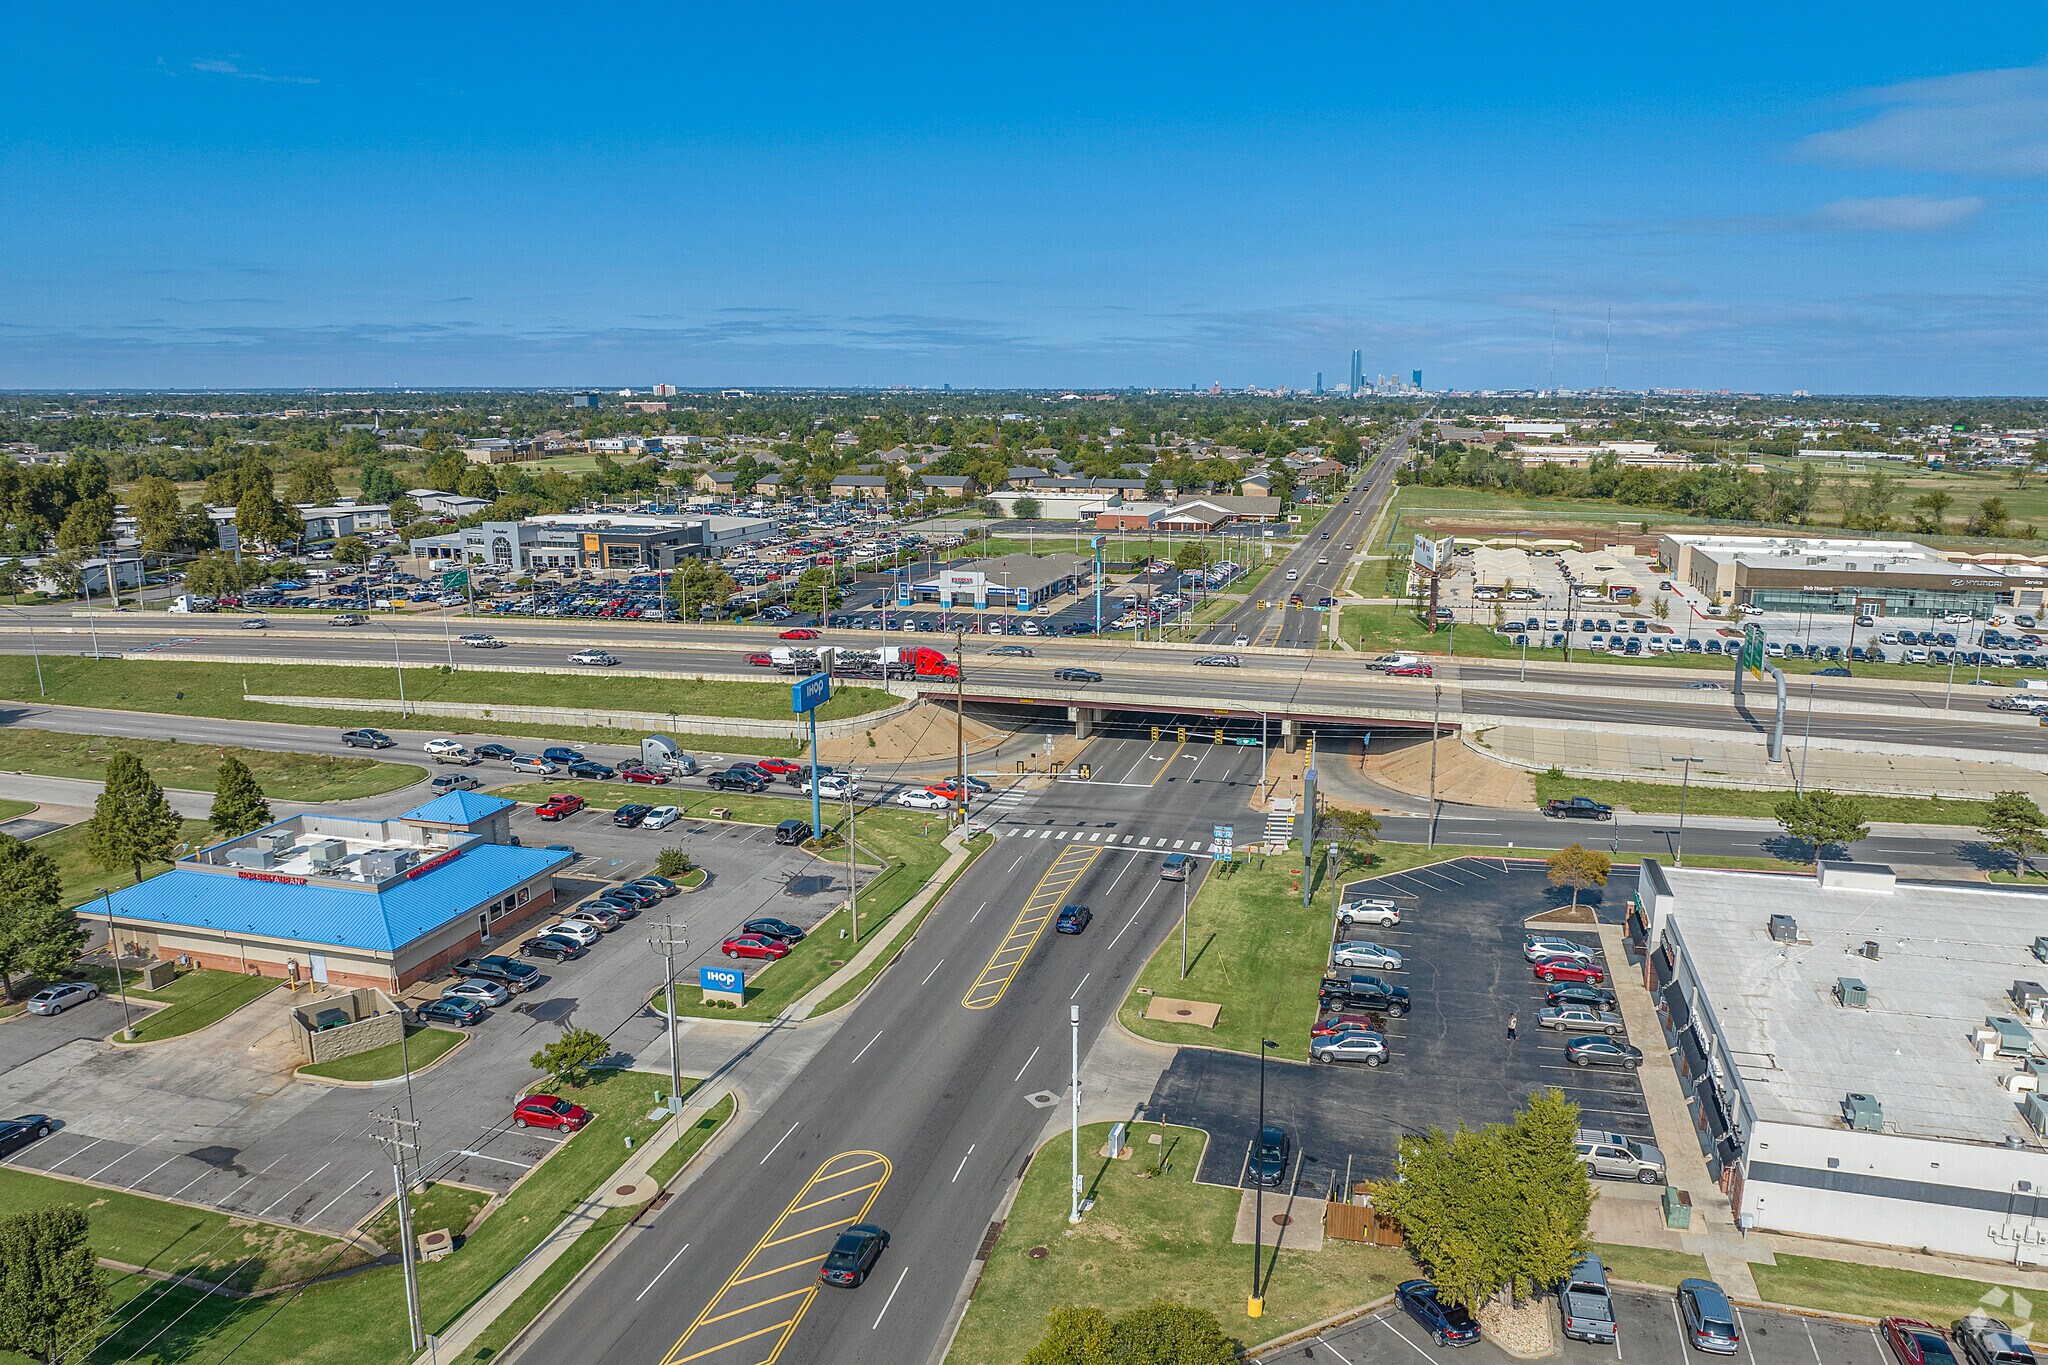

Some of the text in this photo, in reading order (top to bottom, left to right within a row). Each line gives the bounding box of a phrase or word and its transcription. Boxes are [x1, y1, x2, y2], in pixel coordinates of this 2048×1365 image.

[806, 679, 824, 698] IHOP
[238, 871, 306, 886] IHOP RESTAURANT
[707, 971, 736, 985] IHOP
